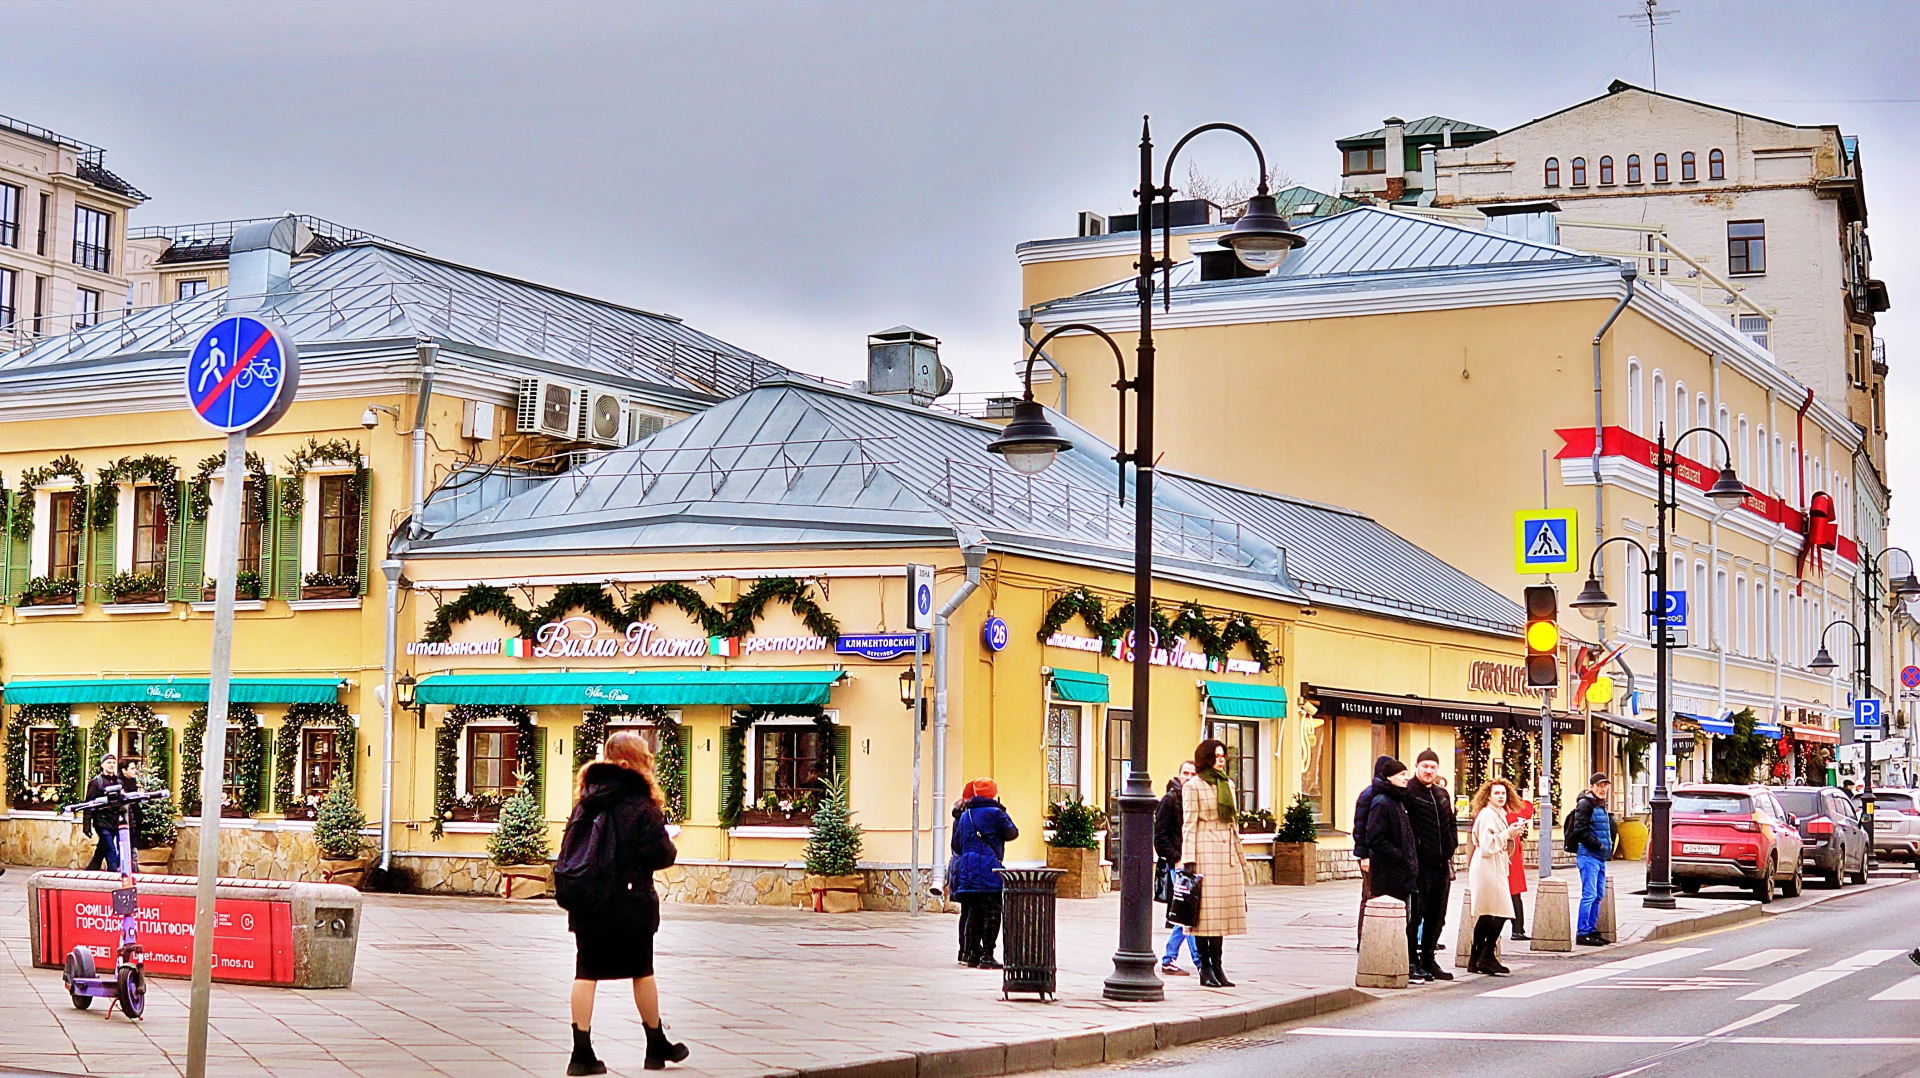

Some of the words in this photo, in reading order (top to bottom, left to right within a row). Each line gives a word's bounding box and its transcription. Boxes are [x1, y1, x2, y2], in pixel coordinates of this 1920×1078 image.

[919, 569, 930, 578] ЗОНА
[406, 637, 501, 656] итальянский
[532, 616, 619, 658] Вилла
[623, 621, 708, 658] Паста
[744, 635, 828, 656] ресторан
[993, 624, 1006, 644] 26
[845, 636, 915, 648] КЛИМЕНТОВСКИЙ
[866, 650, 894, 658] ПЕРЕУЛОК
[1169, 635, 1208, 671] Паста
[584, 684, 604, 698] Villa
[608, 688, 629, 701] Pasta
[1341, 702, 1373, 714] РЕСТОРАН
[1375, 706, 1383, 715] ОТ
[1860, 702, 1875, 724] P
[1440, 711, 1469, 721] РЕСТОРАН
[1470, 713, 1478, 722] ОТ
[76, 916, 138, 933] ГОРОДСКЯ
[139, 920, 196, 937] ПЛАТФОРМ
[221, 958, 254, 968] mos.ru
